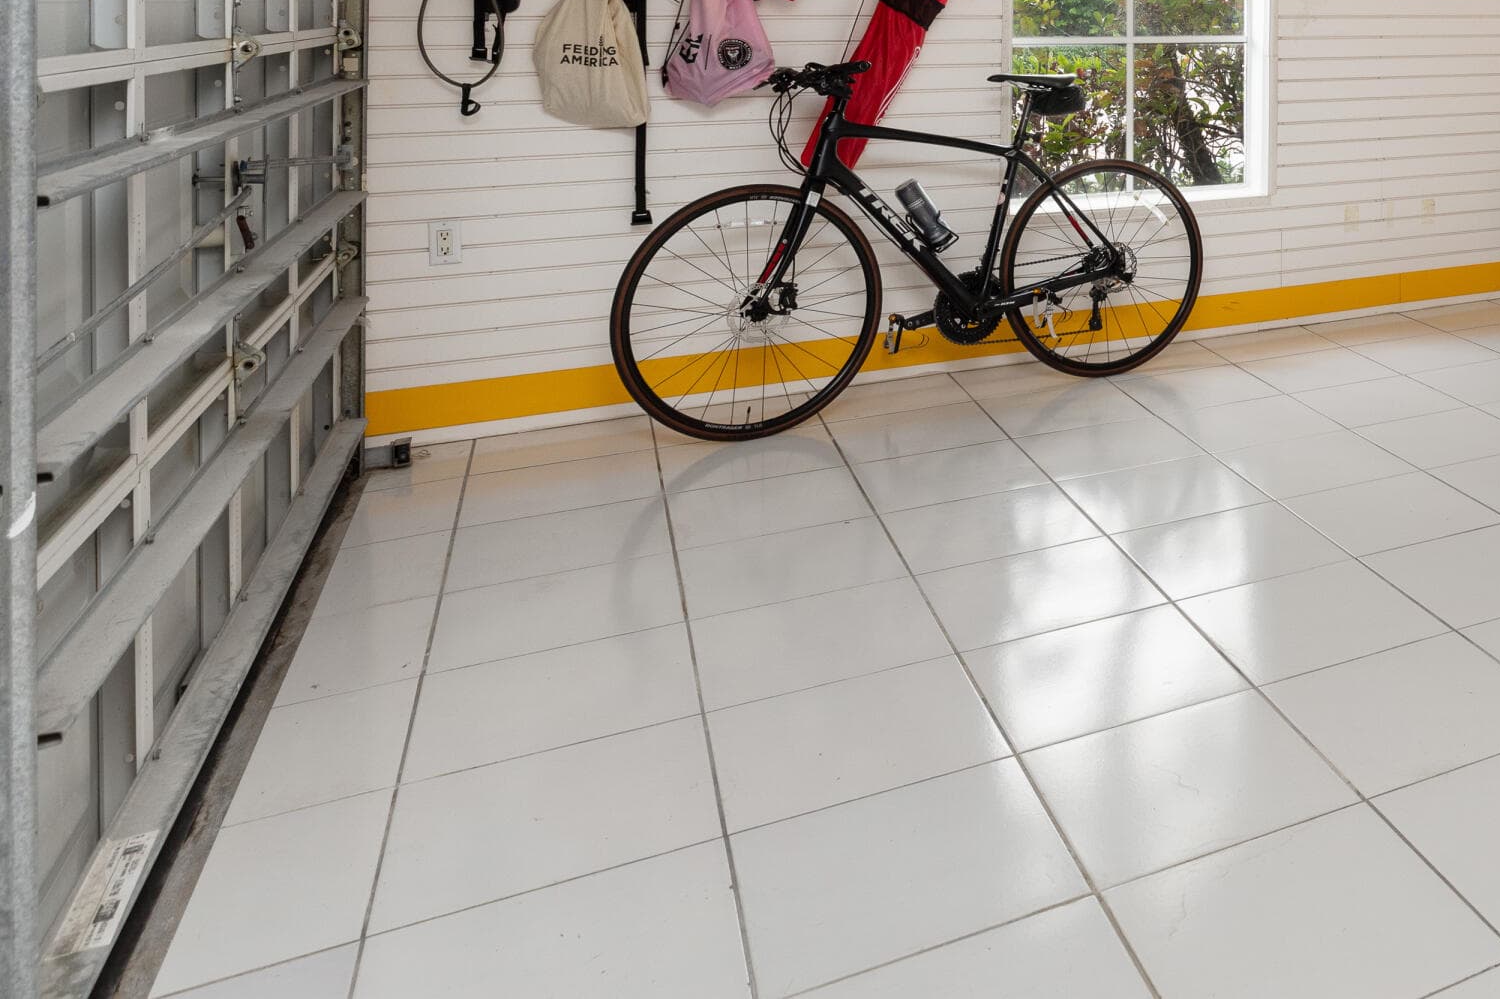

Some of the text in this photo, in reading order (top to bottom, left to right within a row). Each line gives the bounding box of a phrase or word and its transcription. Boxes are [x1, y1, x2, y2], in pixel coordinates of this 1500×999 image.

[562, 42, 616, 57] FEEDING
[560, 55, 619, 67] AMERICA
[859, 181, 928, 252] TREK
